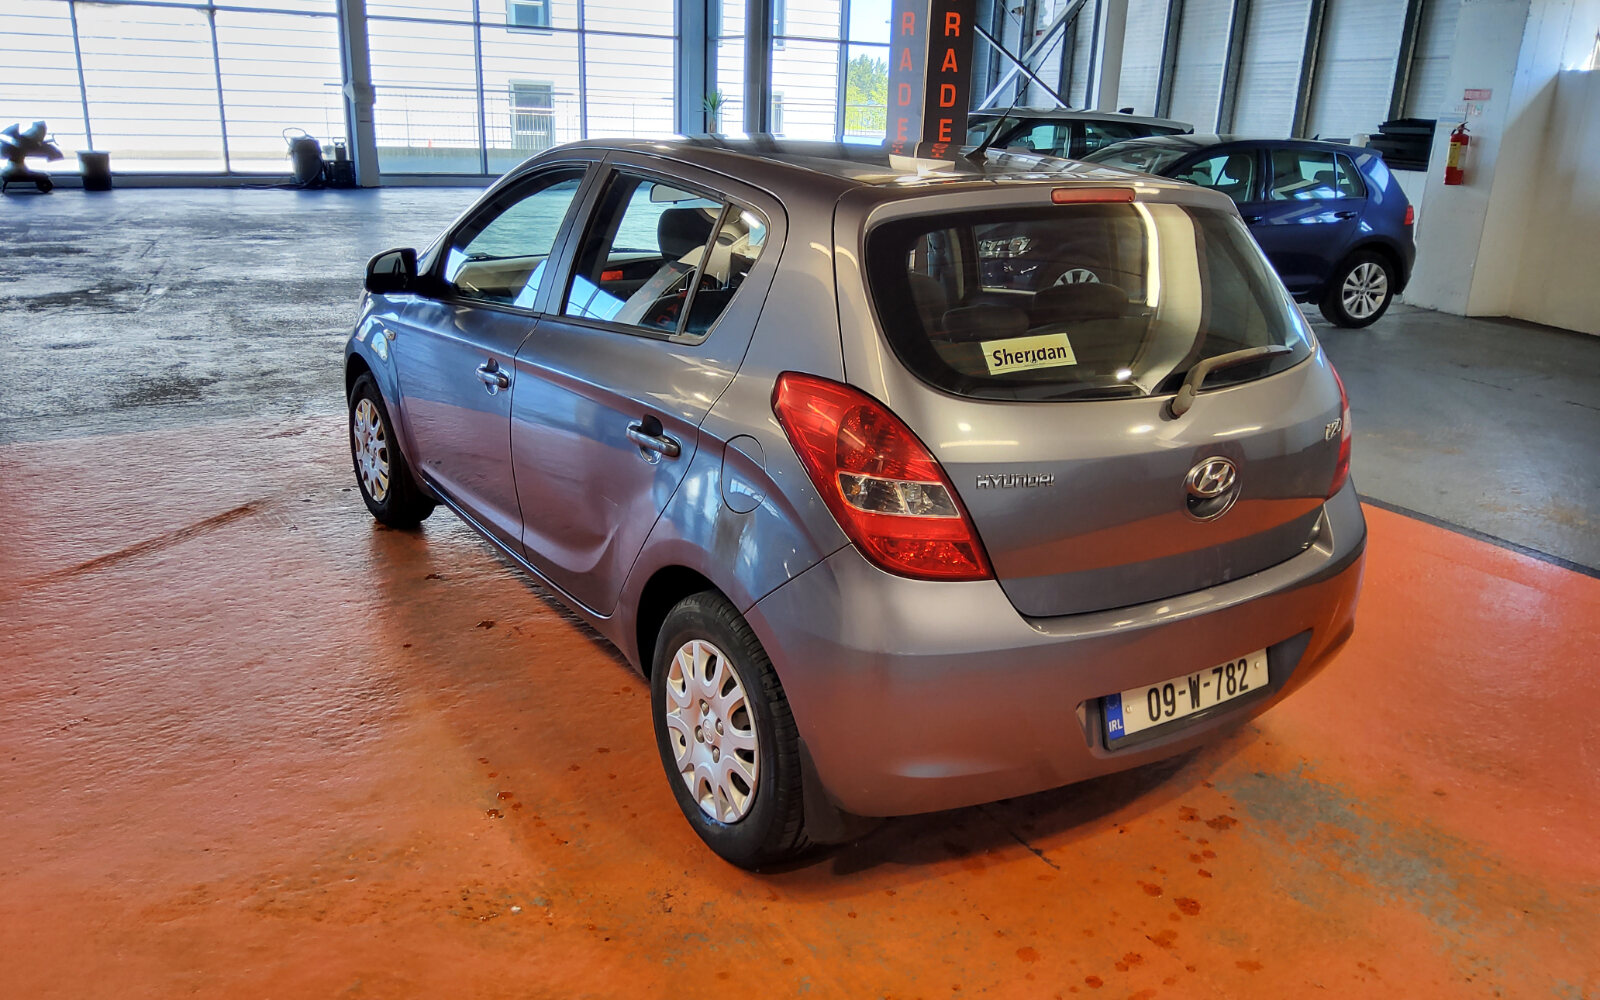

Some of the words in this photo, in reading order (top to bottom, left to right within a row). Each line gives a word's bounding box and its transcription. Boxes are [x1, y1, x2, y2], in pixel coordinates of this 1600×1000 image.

[897, 12, 915, 142] RADE
[938, 0, 961, 142] RADE
[992, 345, 1067, 367] Sheridan
[976, 473, 1055, 489] HYUNDAI
[1147, 658, 1249, 722] 09-W-782
[1108, 719, 1123, 733] IRL
